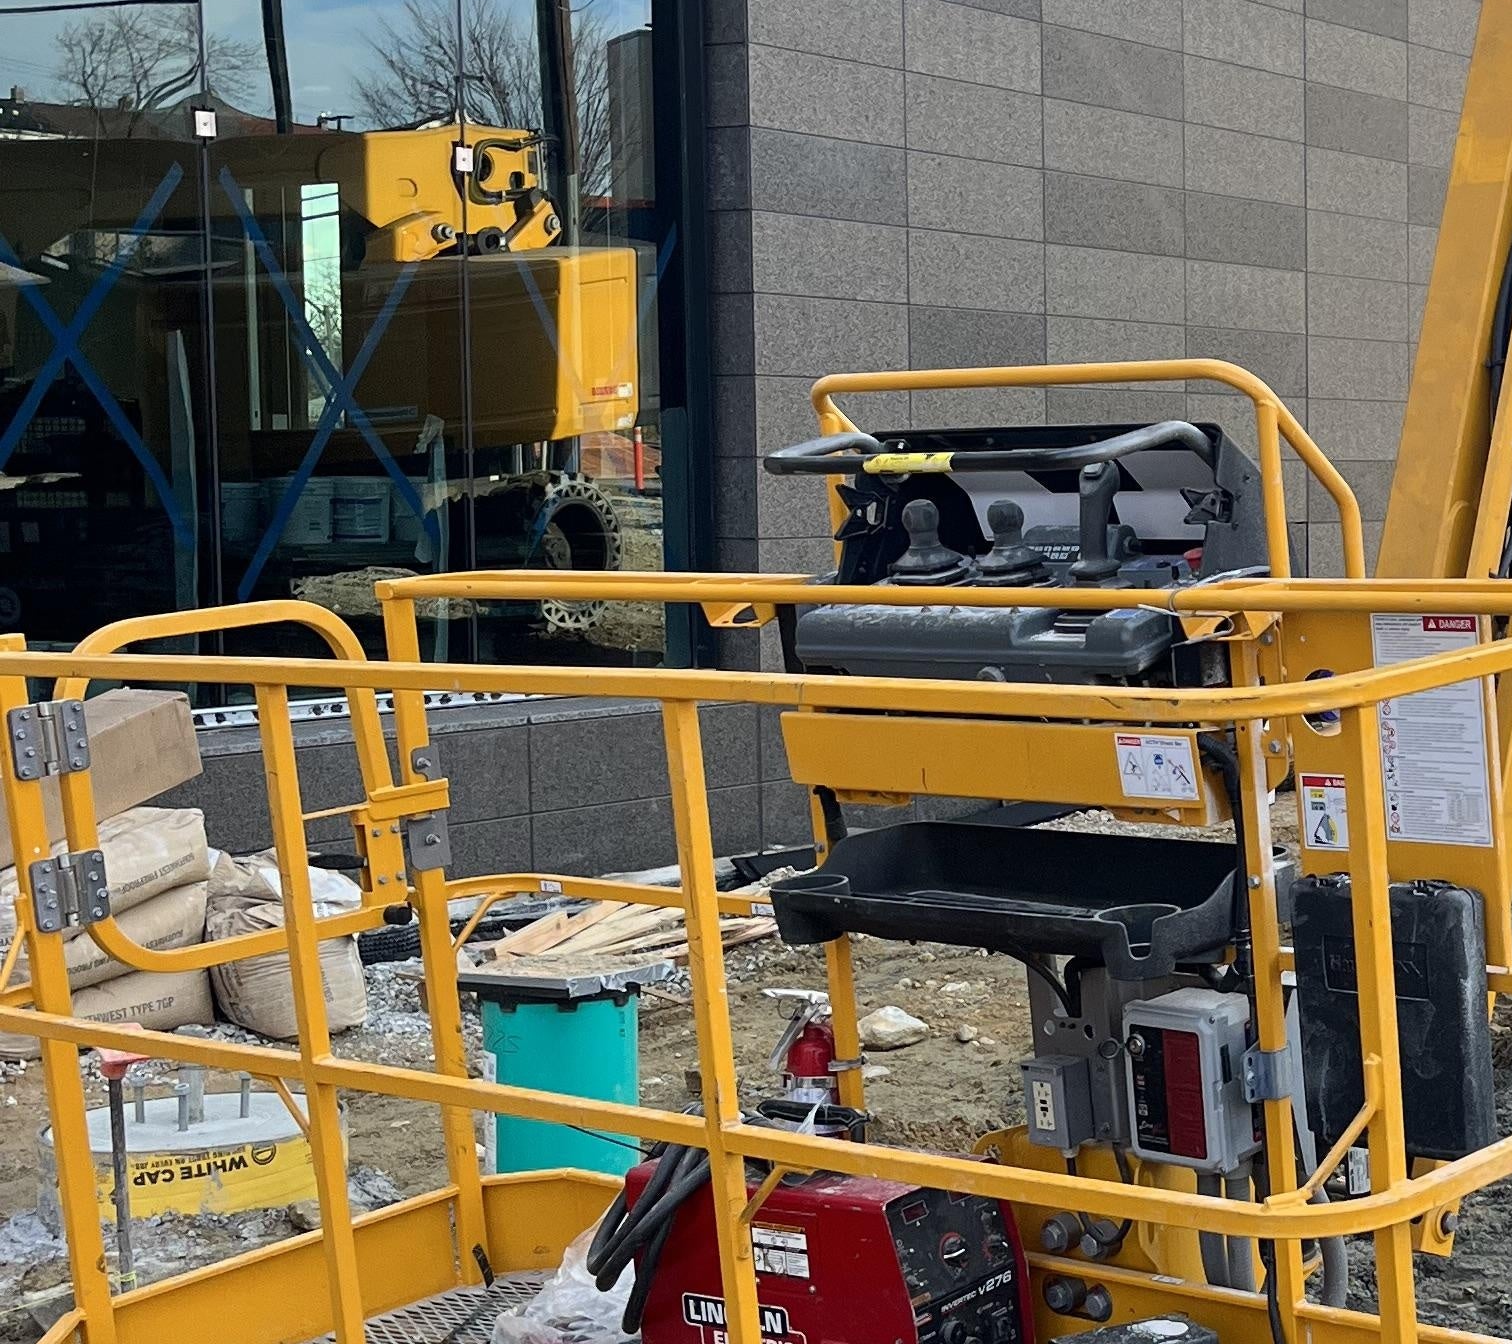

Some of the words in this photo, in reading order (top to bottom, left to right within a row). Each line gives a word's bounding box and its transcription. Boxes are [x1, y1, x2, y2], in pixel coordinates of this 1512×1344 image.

[1438, 619, 1472, 630] DANGER
[130, 1000, 155, 1017] TYPE
[133, 1168, 175, 1186] CAP
[180, 1155, 249, 1180] WHITE
[940, 1289, 977, 1313] INVERTEC
[688, 1299, 783, 1334] LINN
